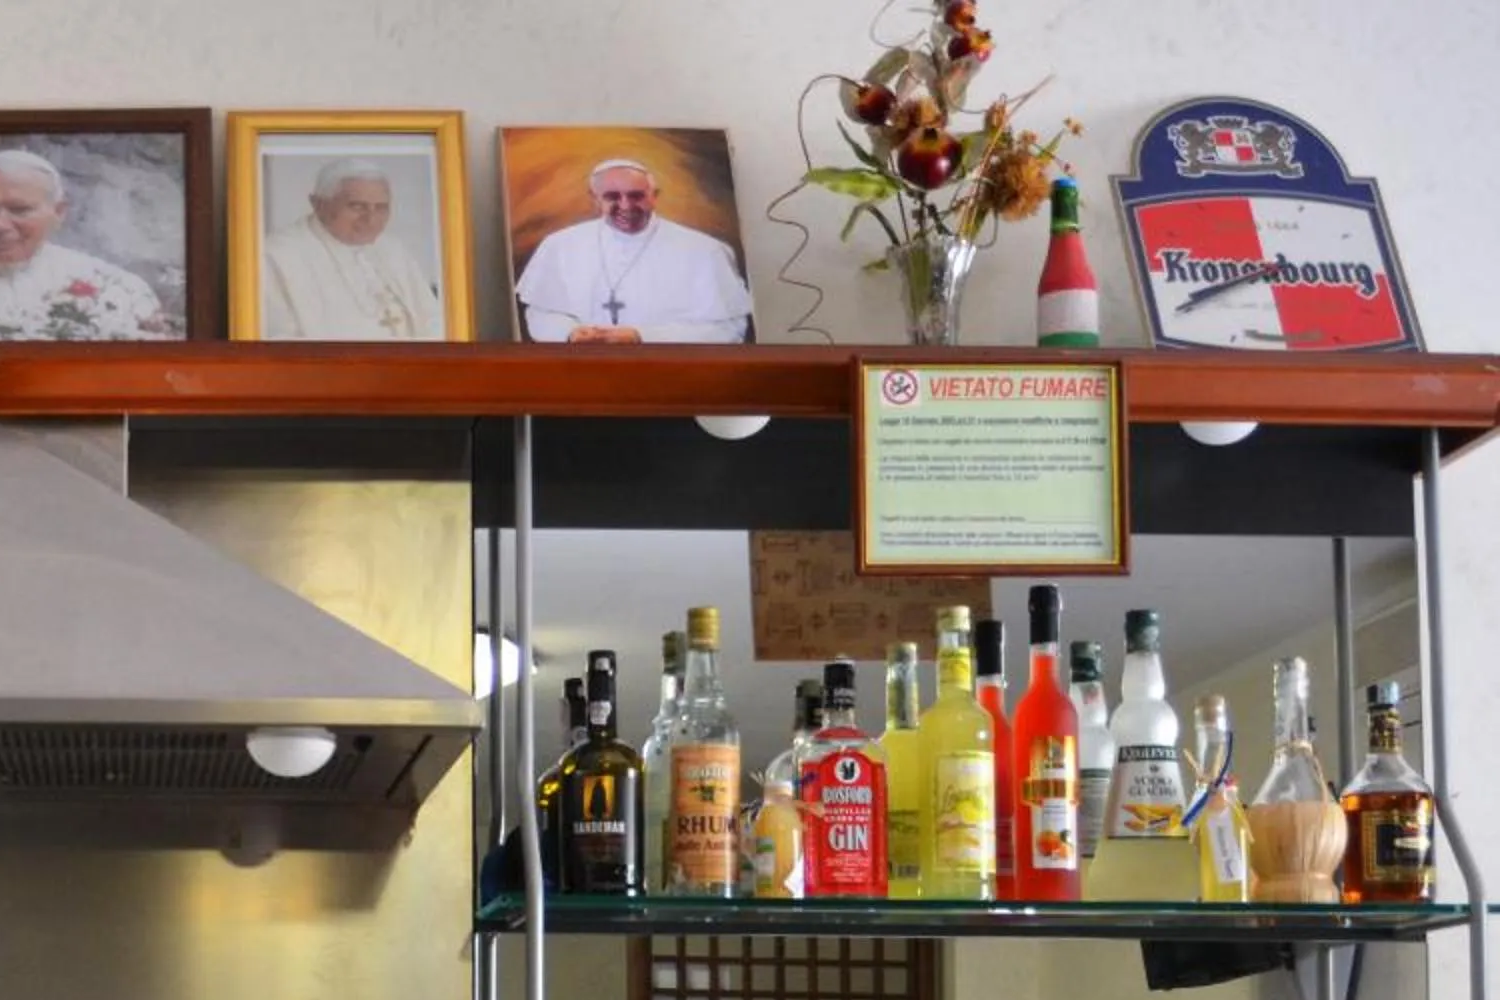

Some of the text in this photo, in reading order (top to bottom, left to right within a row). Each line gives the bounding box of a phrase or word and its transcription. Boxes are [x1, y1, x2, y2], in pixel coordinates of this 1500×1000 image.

[929, 377, 1108, 397] VIETATO FUMARE
[676, 815, 738, 834] RHUM
[828, 824, 869, 851] GIN
